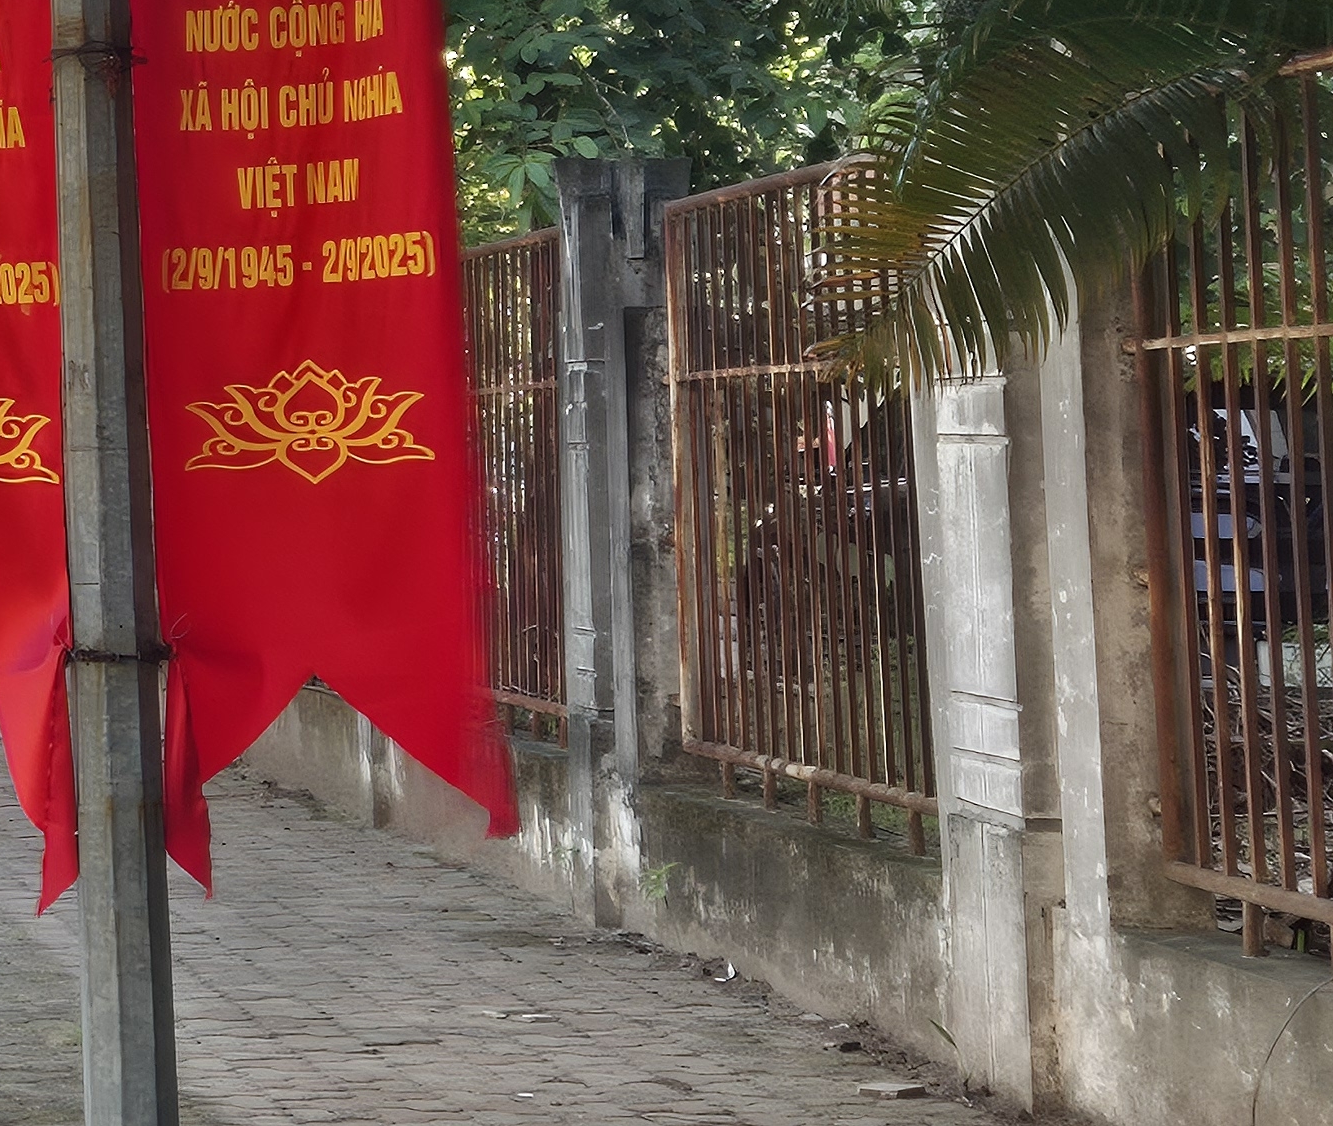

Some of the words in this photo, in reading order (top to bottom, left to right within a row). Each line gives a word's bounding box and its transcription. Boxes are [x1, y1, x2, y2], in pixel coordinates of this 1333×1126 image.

[186, 0, 259, 52] NƯỚC
[180, 81, 212, 131] XÃ
[221, 78, 269, 140] HỘI
[279, 67, 334, 128] CHỦ
[237, 156, 297, 218] VIỆT
[306, 157, 360, 205] NAM
[161, 244, 294, 294] (2/9/1945
[302, 261, 312, 271] -
[322, 230, 435, 283] 2/9/2025)
